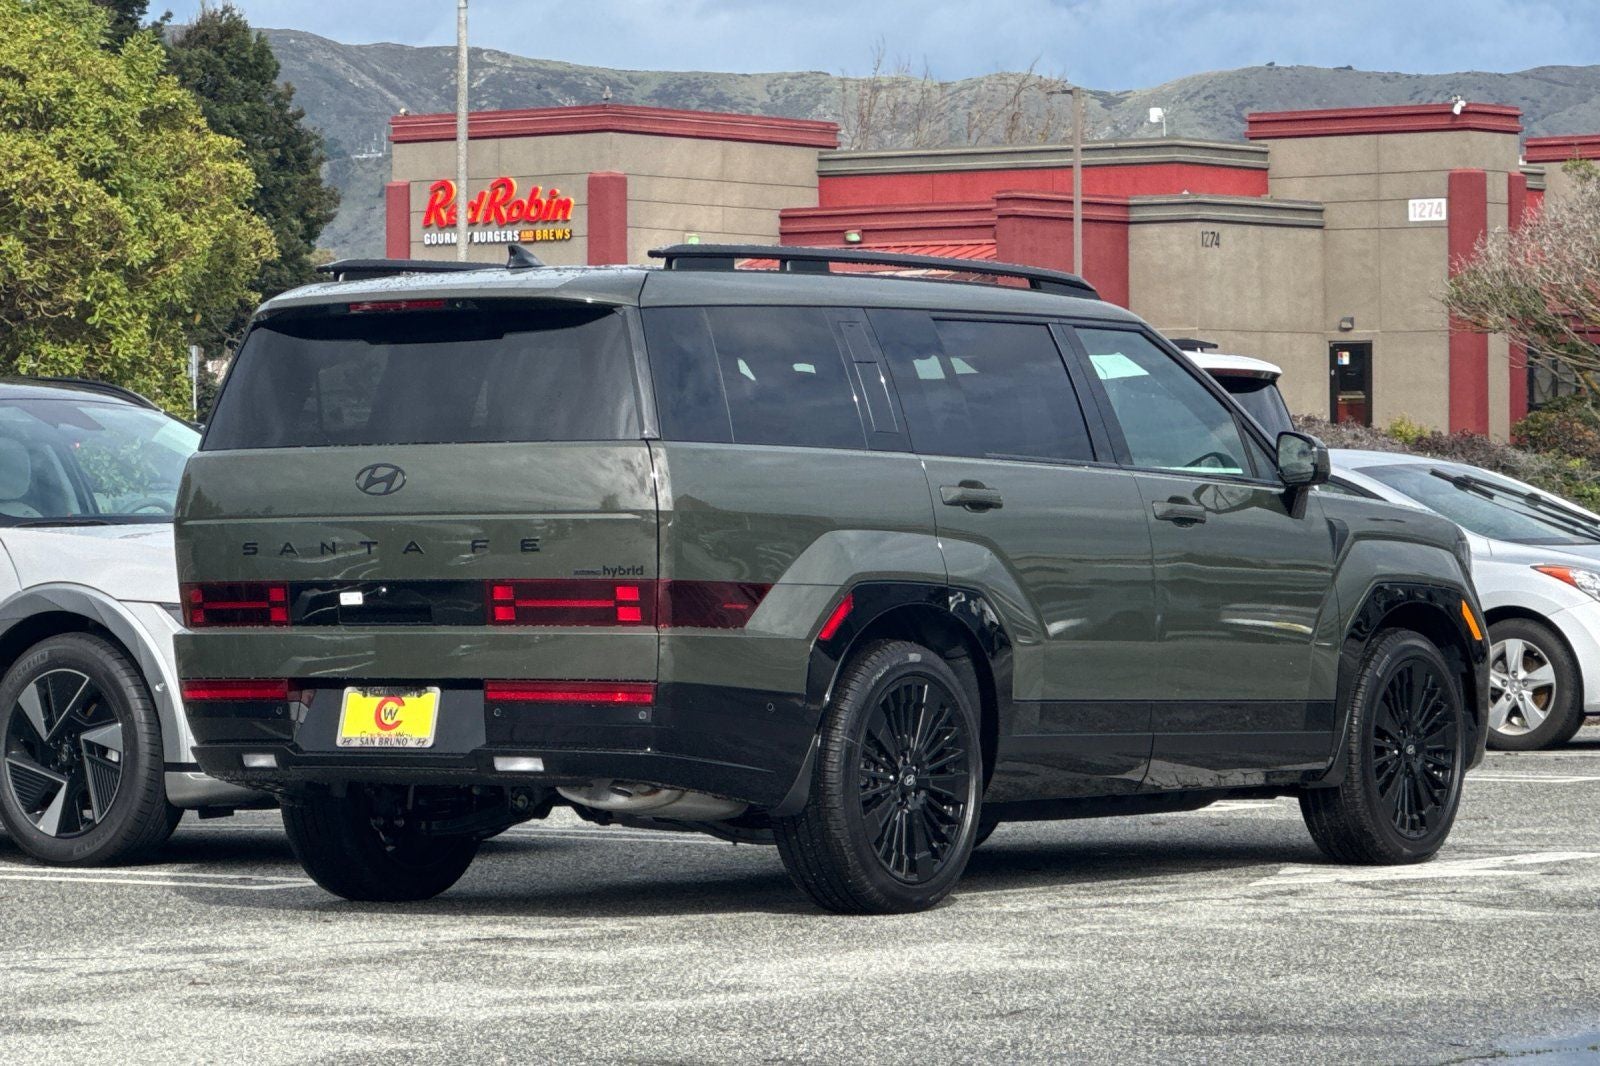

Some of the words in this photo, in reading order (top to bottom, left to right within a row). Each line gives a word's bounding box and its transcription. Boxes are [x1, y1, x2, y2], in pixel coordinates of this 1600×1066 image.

[483, 177, 574, 226] Robin
[1411, 202, 1443, 218] 1274
[424, 232, 471, 245] GOURMT
[473, 230, 519, 243] BURGERS
[520, 230, 534, 241] AND
[535, 228, 571, 241] BREWS
[1201, 230, 1220, 248] 1274
[242, 540, 425, 556] SANTA
[471, 538, 540, 554] FE
[602, 565, 644, 577] hybrid
[383, 707, 398, 721] W
[359, 737, 376, 746] SAN
[378, 737, 408, 746] BRUNO
